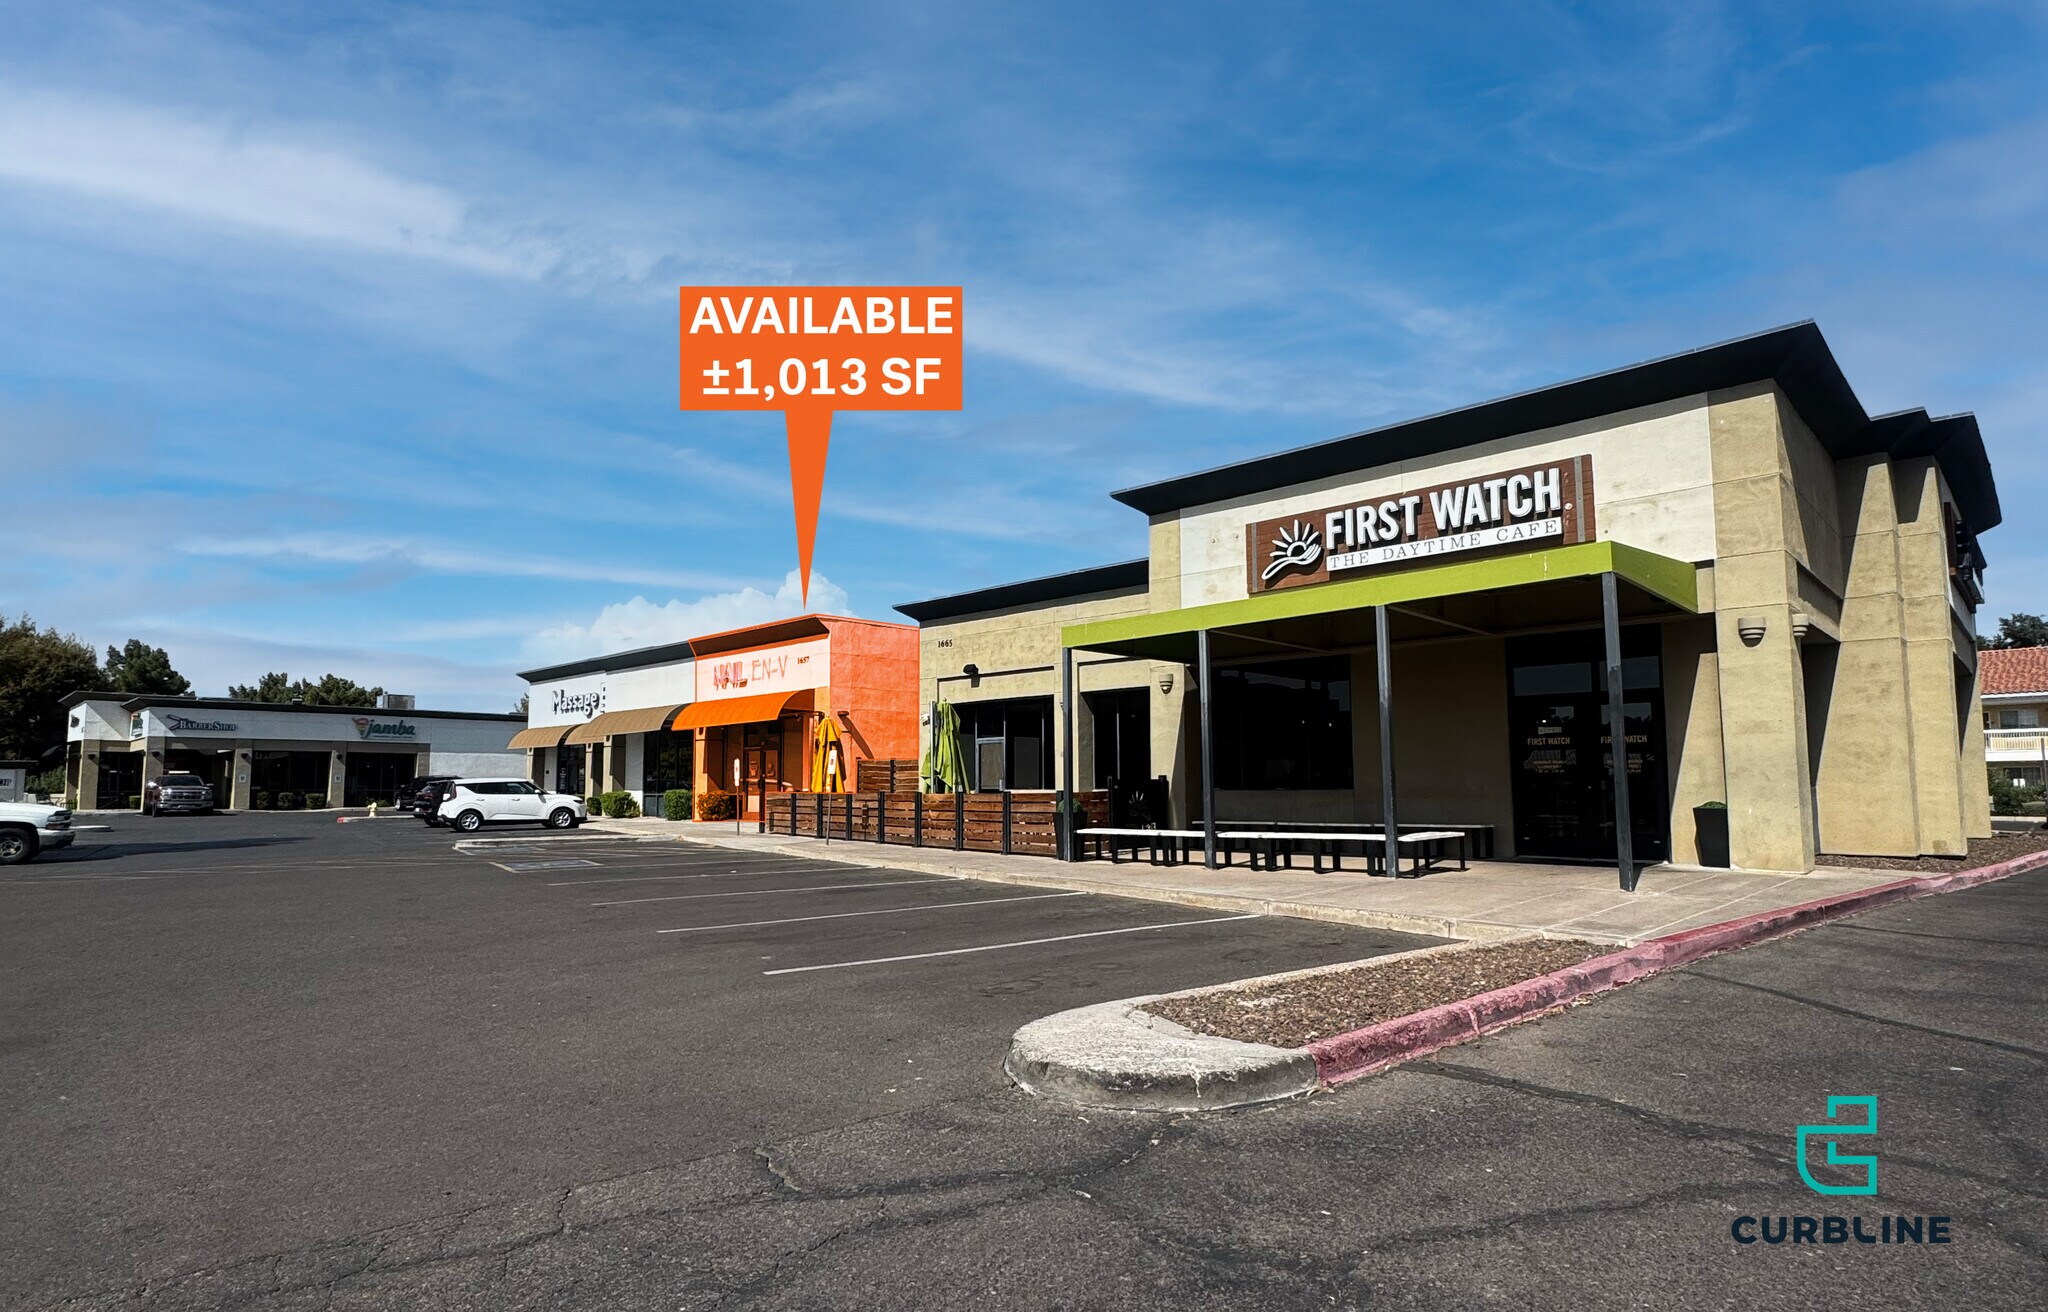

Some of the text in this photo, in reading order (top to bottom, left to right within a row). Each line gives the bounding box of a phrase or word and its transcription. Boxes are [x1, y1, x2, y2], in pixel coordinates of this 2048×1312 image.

[1325, 467, 1562, 549] FIRST WATCH
[1331, 520, 1557, 569] THE DAYTIME CAFE
[937, 638, 953, 648] 1665
[797, 656, 810, 664] 1657
[713, 661, 748, 690] NAIL
[552, 689, 599, 718] Massage
[360, 719, 416, 739] jamba
[1527, 737, 1570, 745] FIRST WATCH
[1600, 736, 1613, 744] FIR
